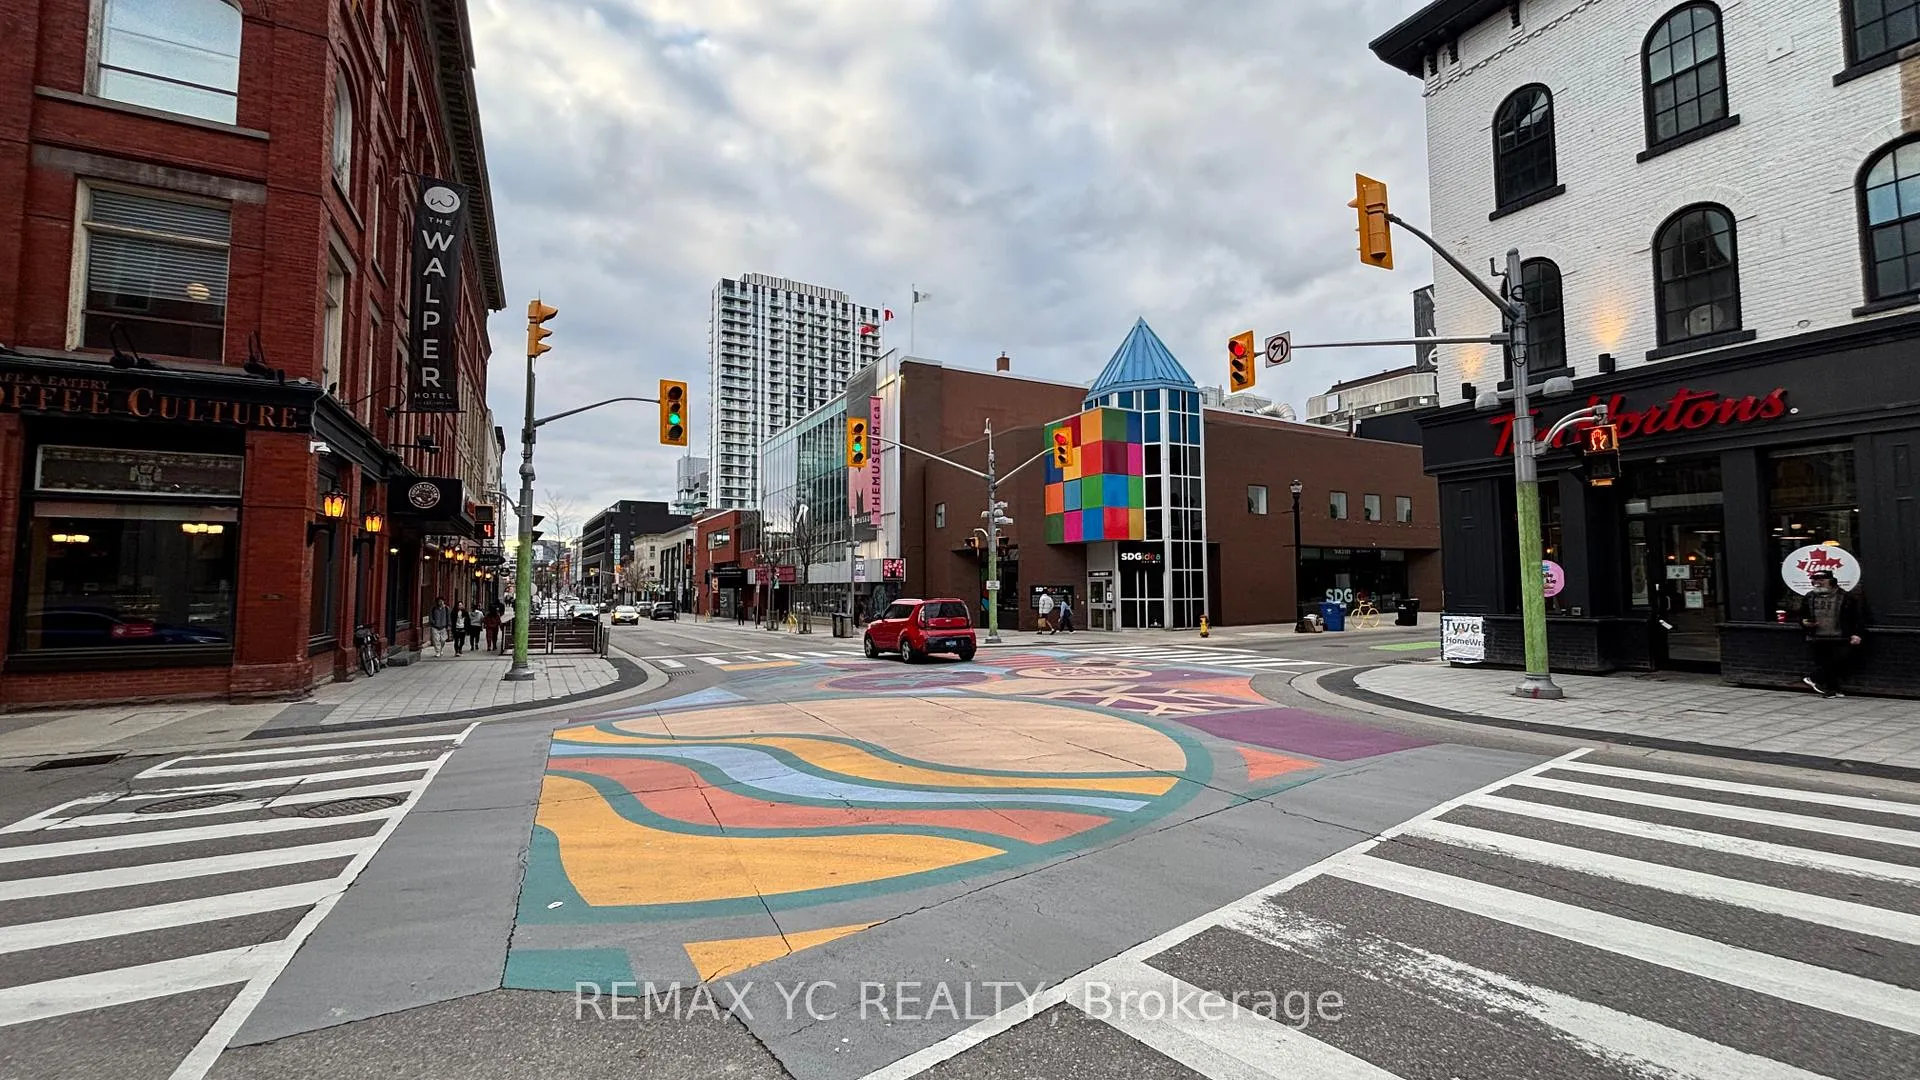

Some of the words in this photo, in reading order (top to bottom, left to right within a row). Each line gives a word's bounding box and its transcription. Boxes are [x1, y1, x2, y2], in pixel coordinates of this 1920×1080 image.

[428, 216, 451, 226] THE
[421, 230, 455, 388] WALPER
[31, 375, 42, 385] &
[48, 375, 110, 390] EATERY
[414, 392, 453, 400] HOTEL
[127, 387, 298, 428] CULTURE
[871, 406, 881, 516] THEMUSEUM.ca
[484, 524, 491, 537] 4
[1325, 588, 1353, 603] SDG
